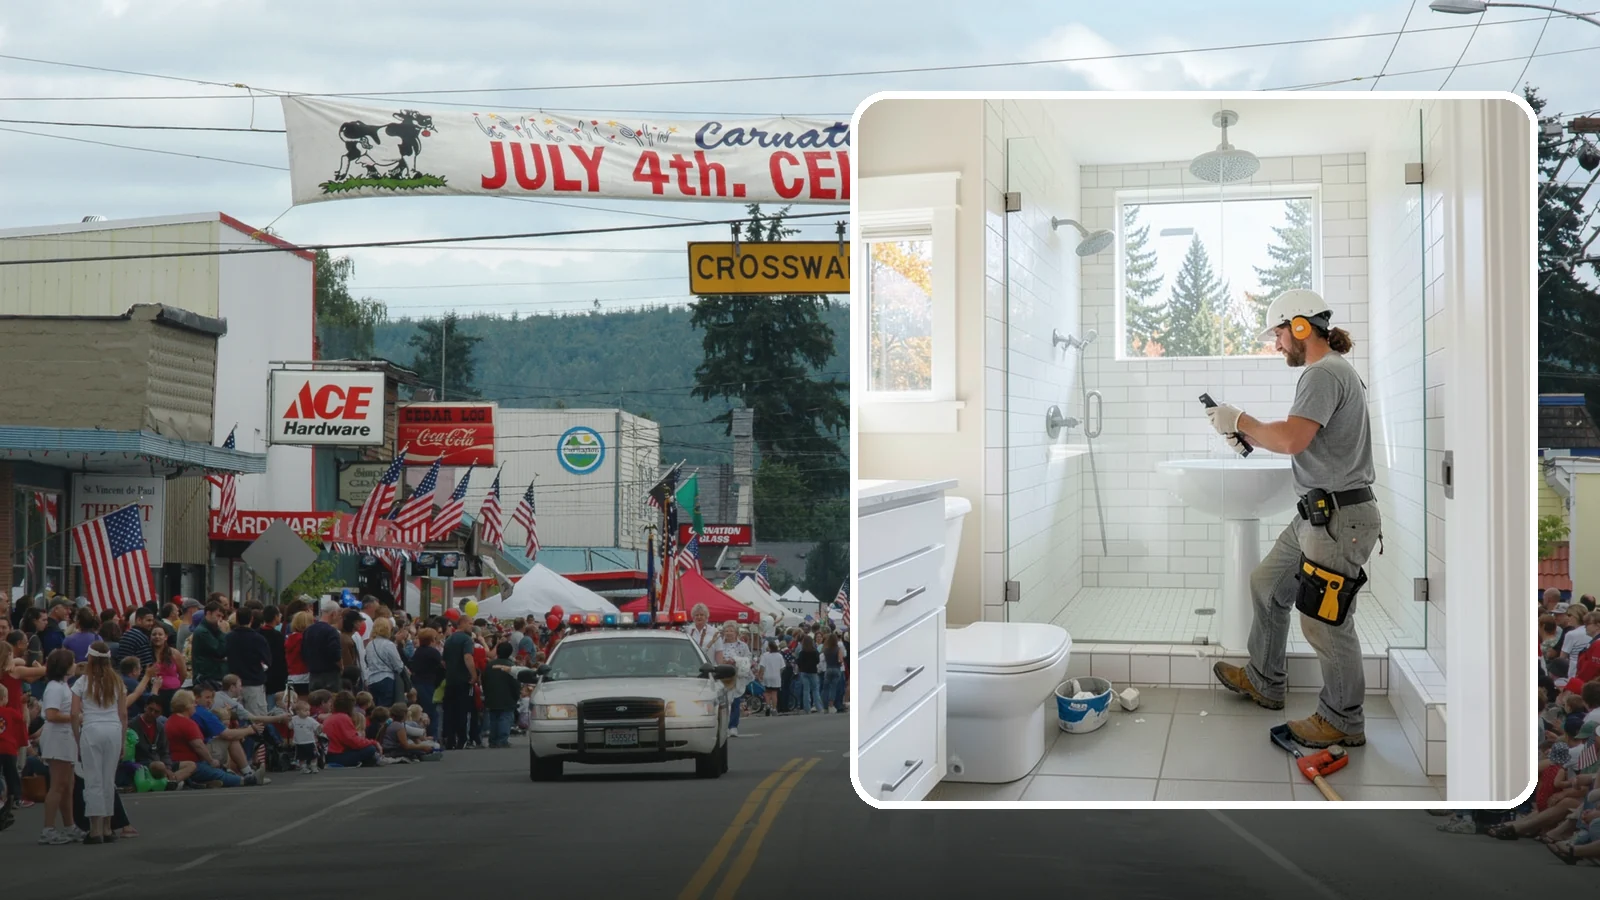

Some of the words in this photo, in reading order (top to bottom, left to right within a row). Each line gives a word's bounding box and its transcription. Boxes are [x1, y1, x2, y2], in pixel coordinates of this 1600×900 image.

[481, 141, 605, 192] JULY
[632, 150, 746, 197] 4th.
[697, 254, 850, 280] CROSSWA
[282, 380, 373, 420] ACE
[283, 421, 370, 436] Hardware
[95, 485, 124, 495] Vincent
[126, 486, 136, 495] de
[138, 486, 155, 496] Paul
[688, 526, 741, 535] CRNATION
